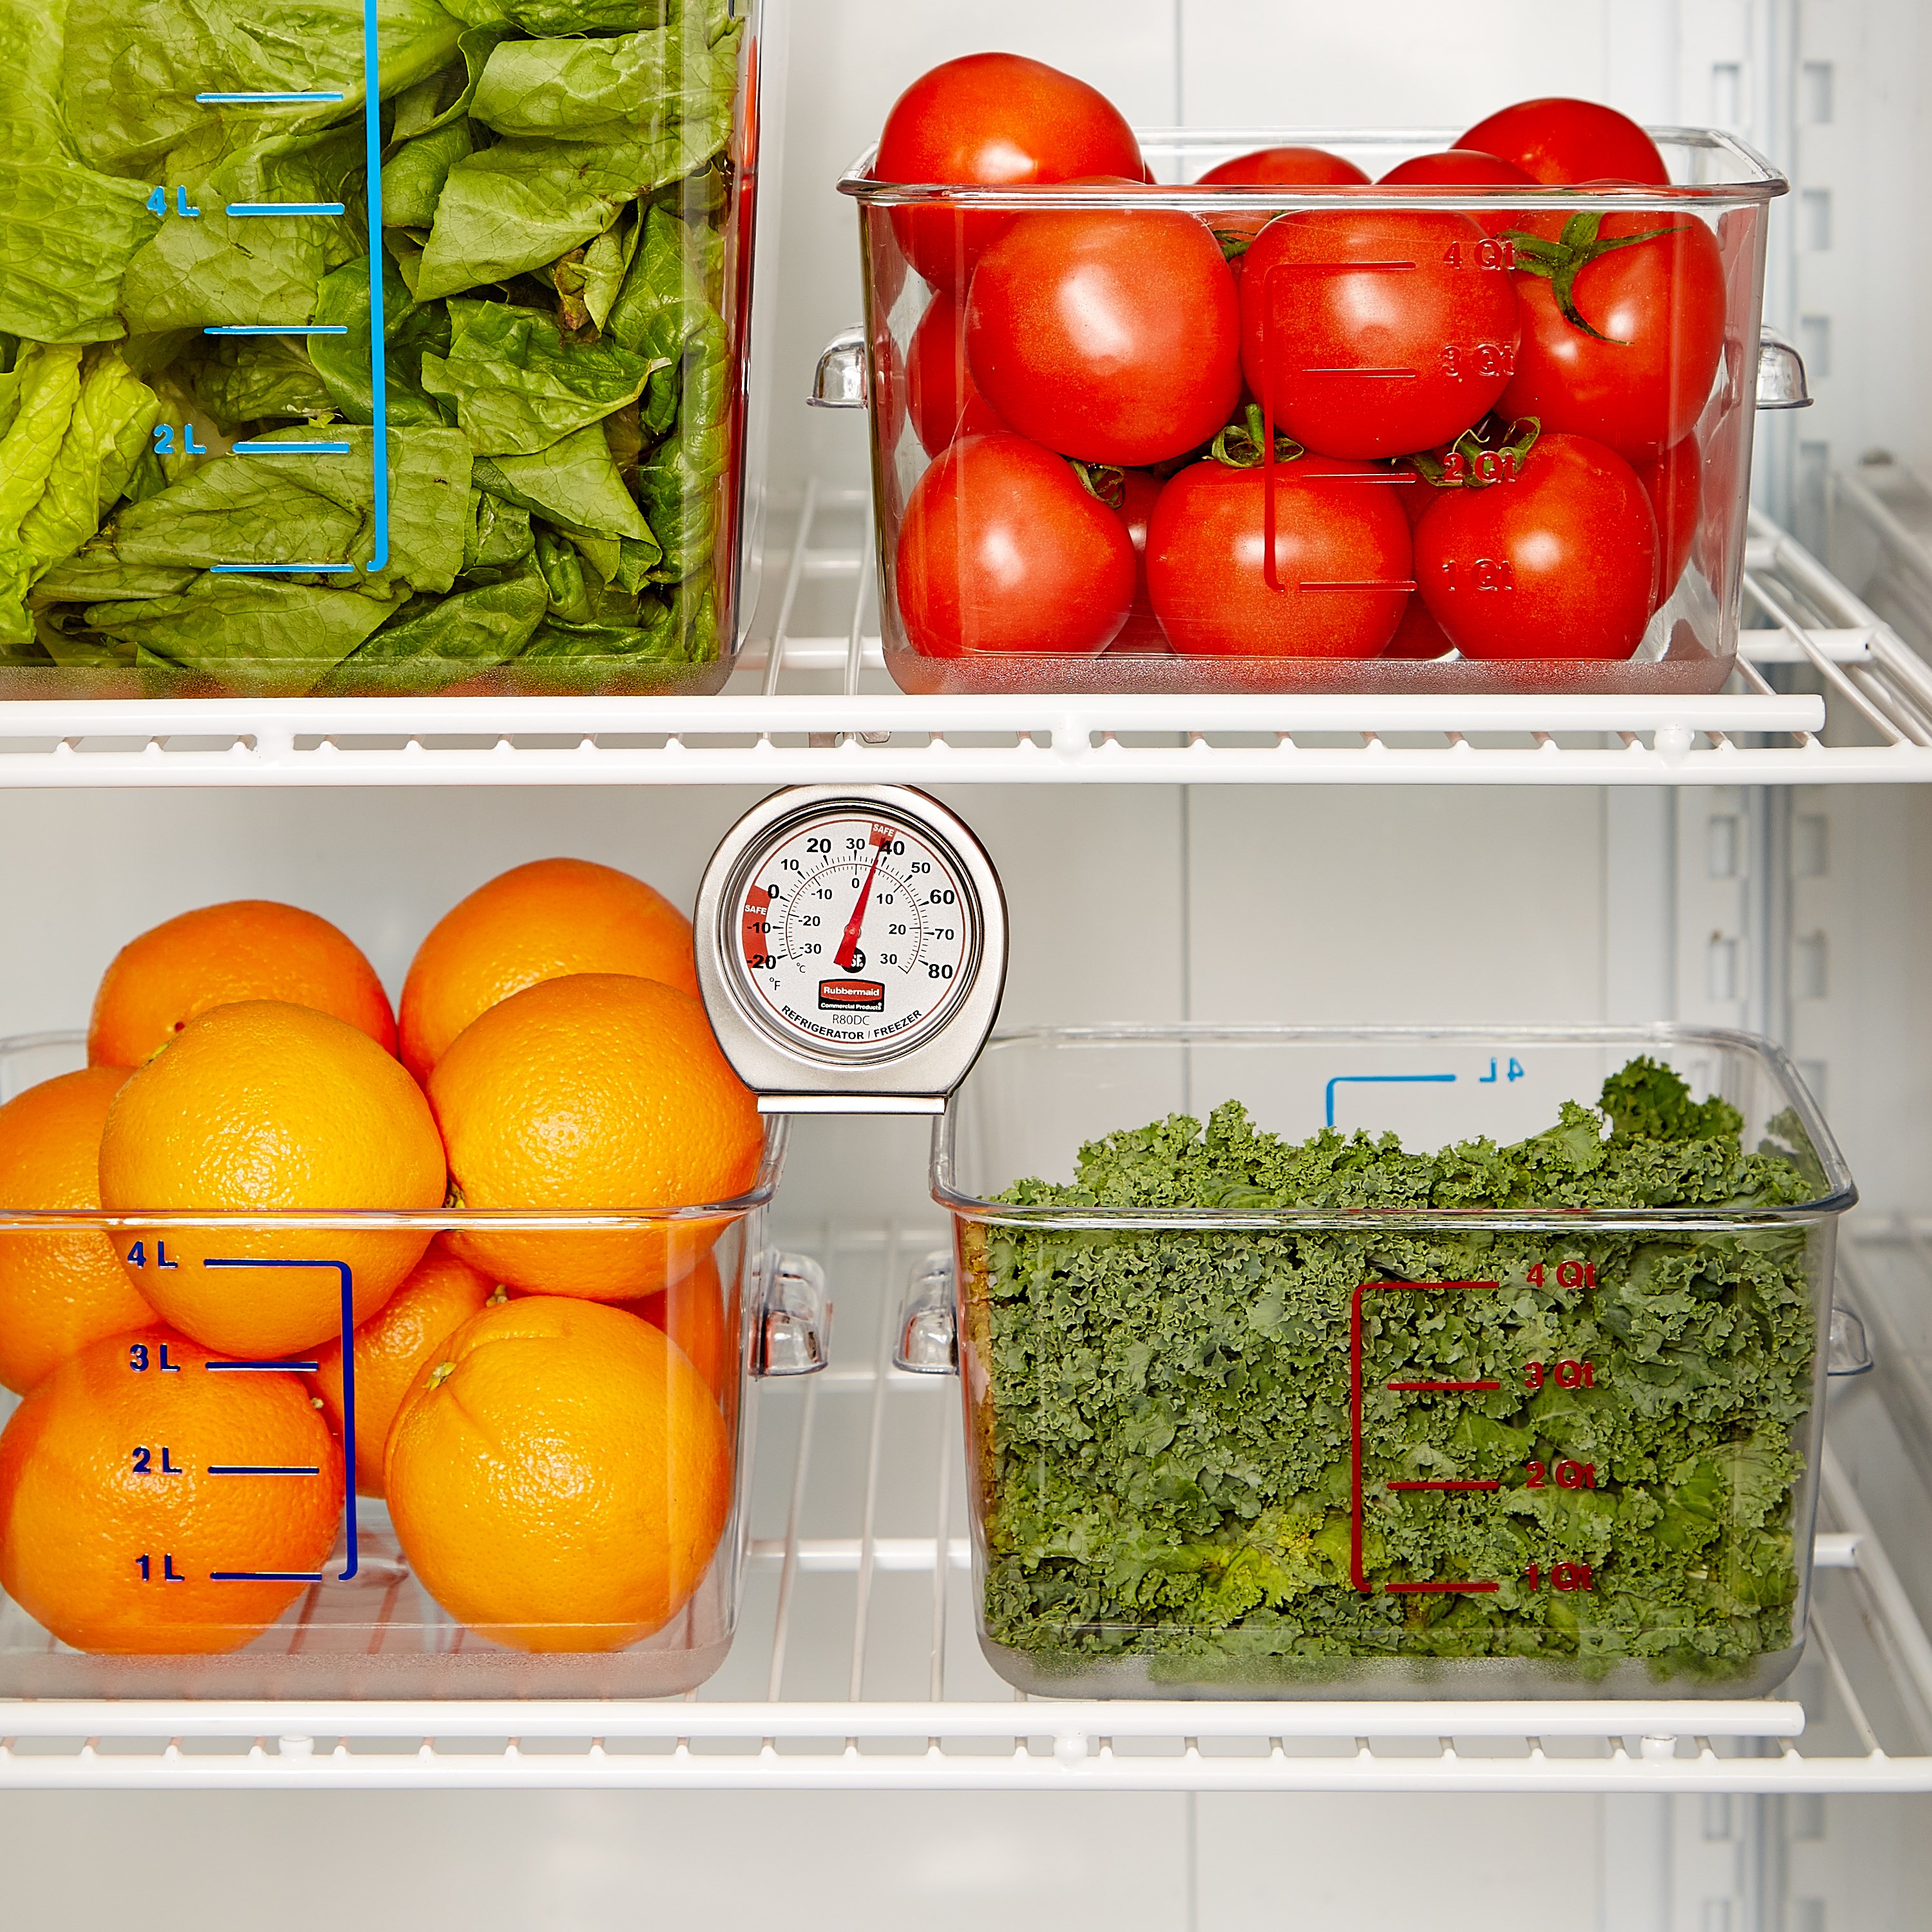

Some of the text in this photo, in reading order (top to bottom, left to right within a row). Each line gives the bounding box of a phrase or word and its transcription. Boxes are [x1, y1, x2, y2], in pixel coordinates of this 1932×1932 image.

[1443, 239, 1515, 270] 4 Qt
[1442, 343, 1515, 377] 3 Qt
[1443, 451, 1516, 484] 2 Qt
[1442, 558, 1514, 591] 1 Qt
[873, 824, 895, 837] SAFE
[806, 838, 831, 853] 20
[846, 838, 865, 849] 30
[880, 840, 905, 855] 40
[781, 859, 799, 870] 10
[911, 862, 931, 873] 50
[851, 878, 860, 889] 0
[768, 884, 779, 899] 0
[876, 893, 893, 904] 10
[930, 889, 954, 904] 60
[744, 905, 767, 915] SAFE
[888, 923, 906, 935] 20
[880, 953, 897, 965] 30
[928, 963, 953, 979] 80
[824, 986, 880, 996] Rubbermaid
[781, 1005, 864, 1039] REFRIGERATOR
[873, 1010, 922, 1037] FREEZER
[833, 1014, 870, 1025] R80DC
[1526, 1260, 1596, 1291] 4 Qt
[1525, 1359, 1595, 1389] 3 Qt
[1526, 1460, 1596, 1490] 2 Qt
[1526, 1562, 1593, 1591] 1 Qt
